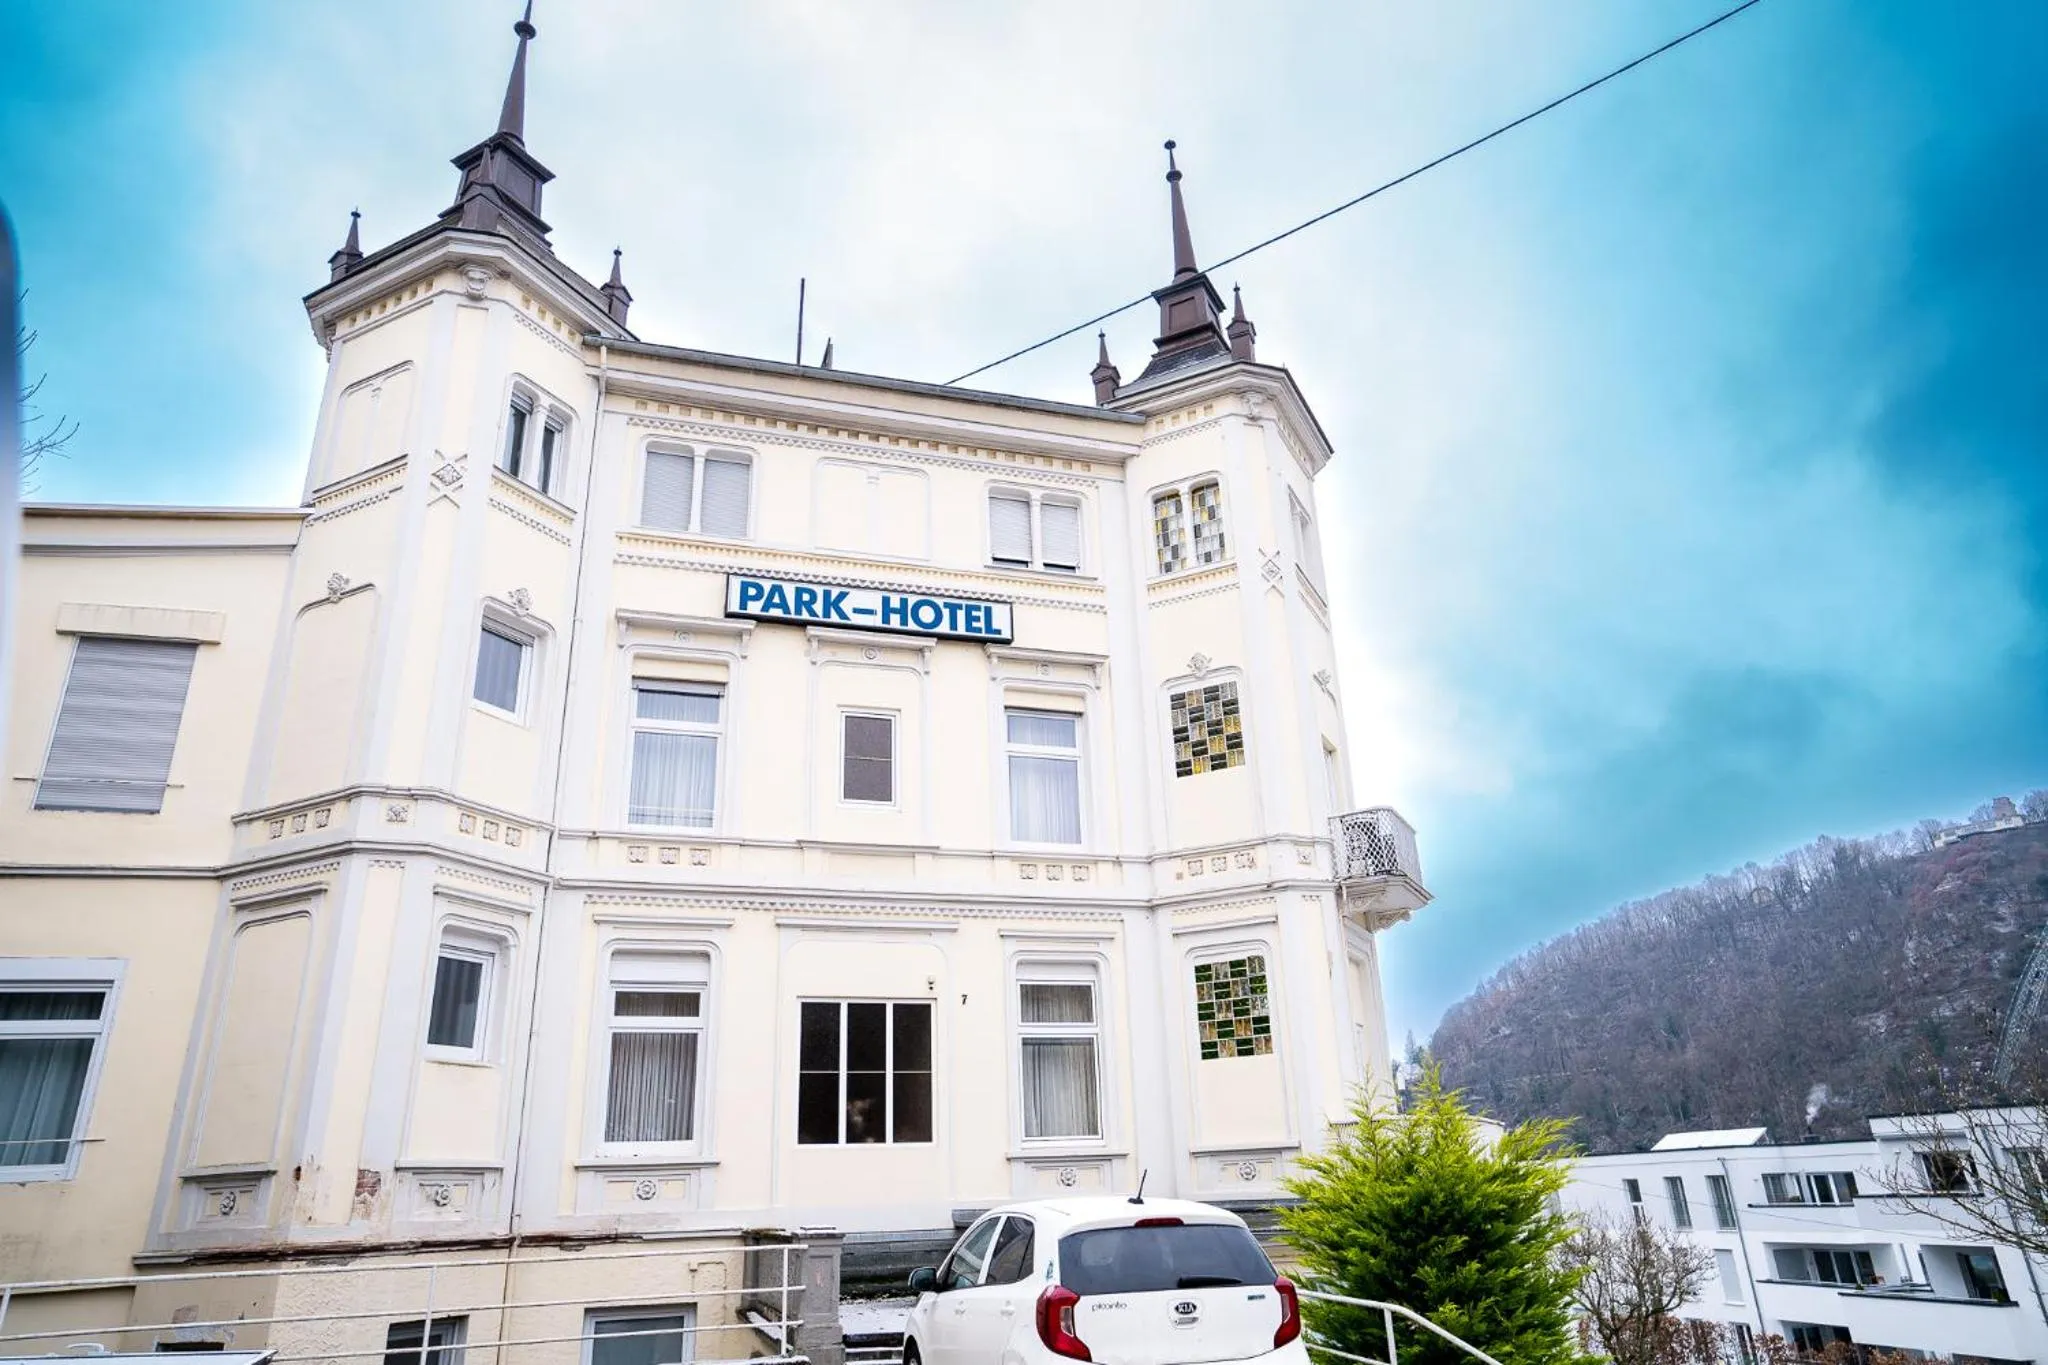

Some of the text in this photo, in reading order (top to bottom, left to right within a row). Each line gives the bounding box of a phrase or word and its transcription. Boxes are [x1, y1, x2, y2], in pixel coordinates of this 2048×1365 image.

[740, 580, 1002, 635] PARK-HOTEL
[961, 994, 968, 1005] 7
[1177, 1302, 1195, 1313] KIA
